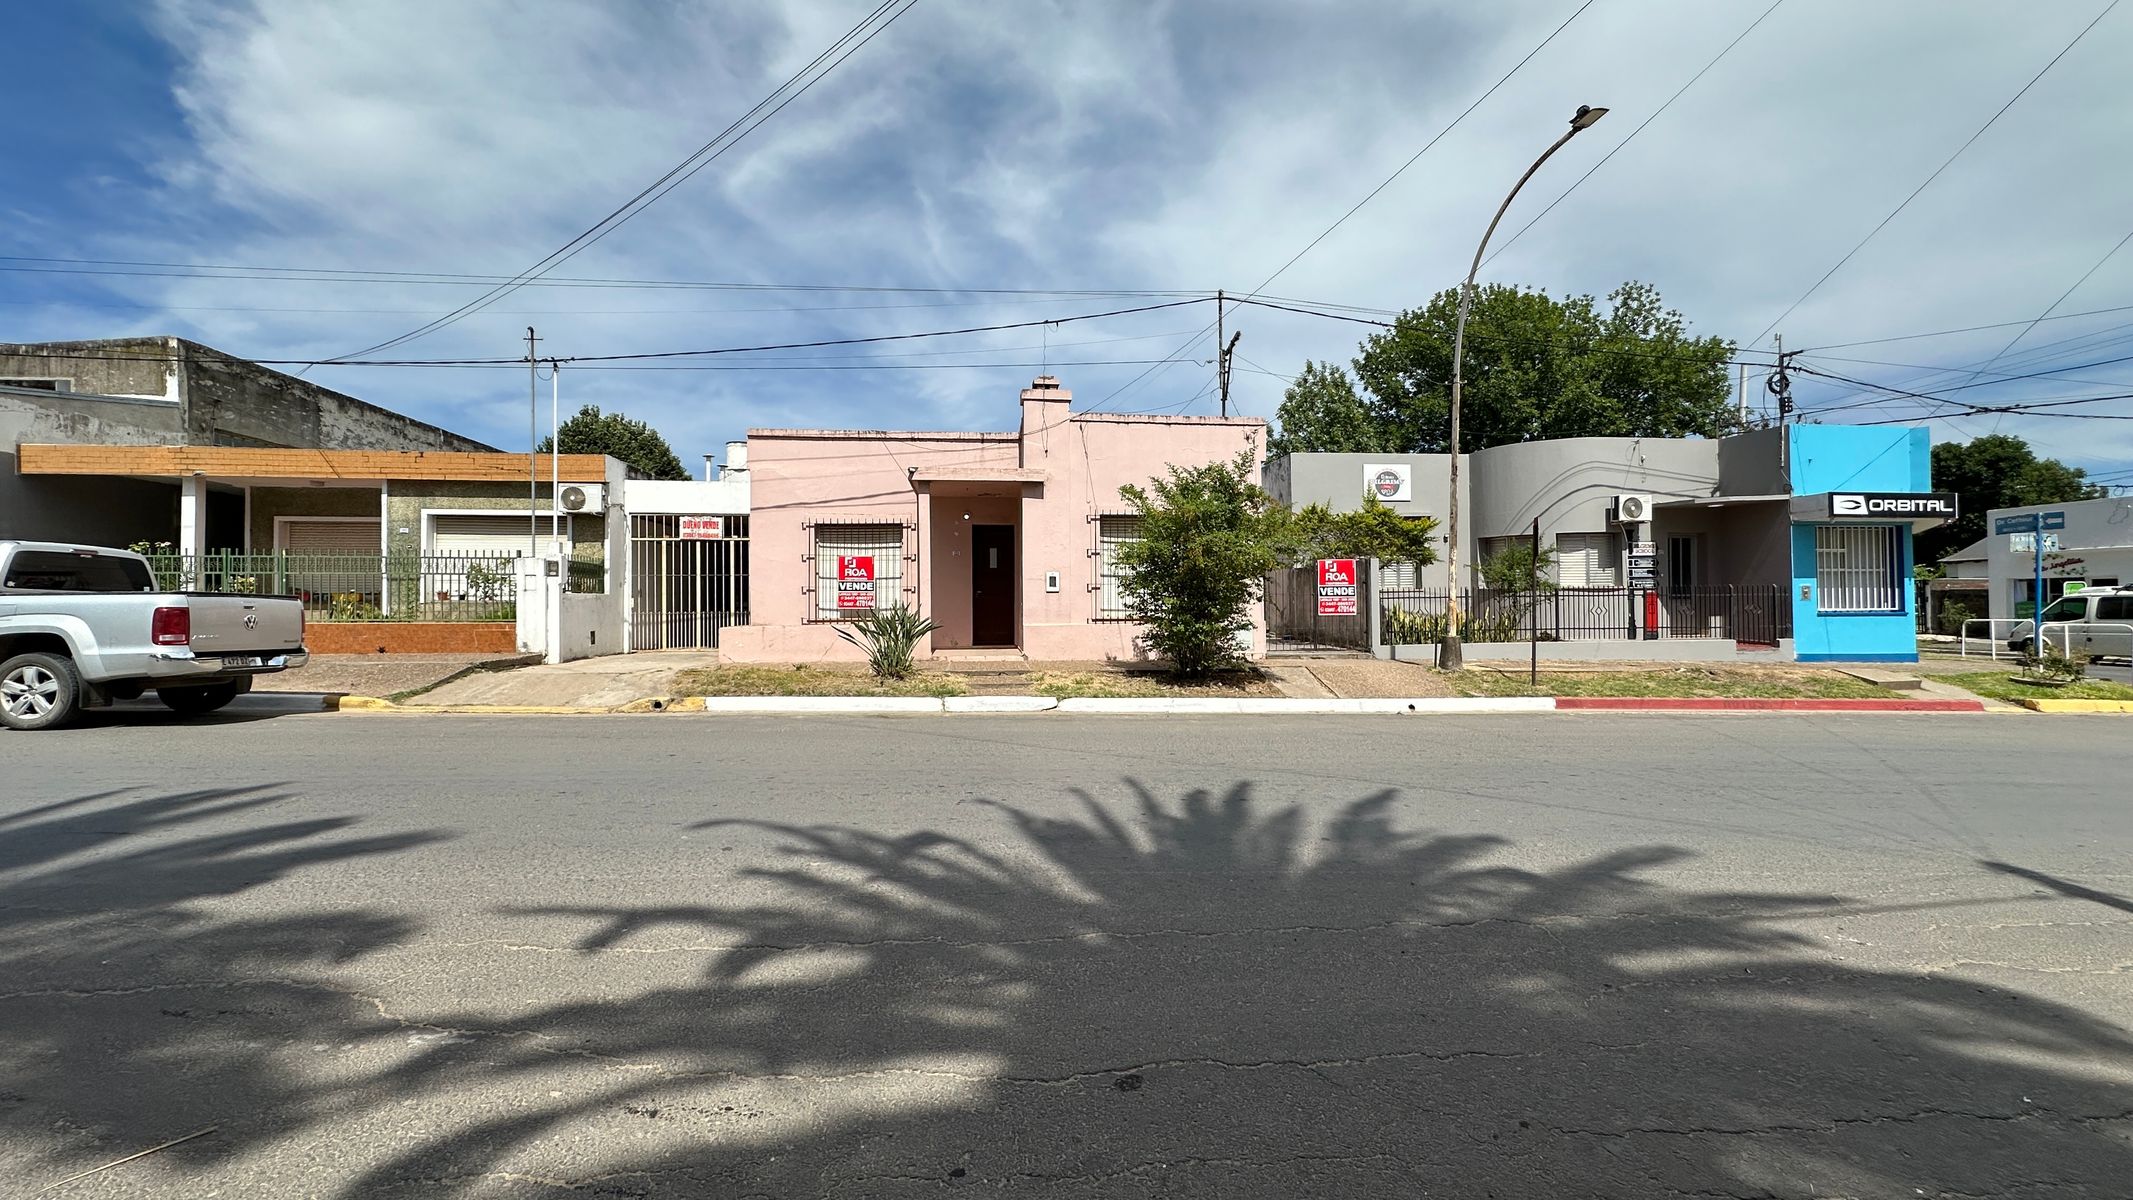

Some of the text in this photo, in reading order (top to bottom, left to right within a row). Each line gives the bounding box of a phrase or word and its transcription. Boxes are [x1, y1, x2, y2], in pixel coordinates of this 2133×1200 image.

[1868, 499, 1954, 512] ORBITAL
[702, 520, 720, 530] VENDE
[844, 568, 868, 577] ROA
[1325, 572, 1349, 581] ROA
[839, 582, 874, 591] VENDE
[1319, 586, 1355, 596] VENDE
